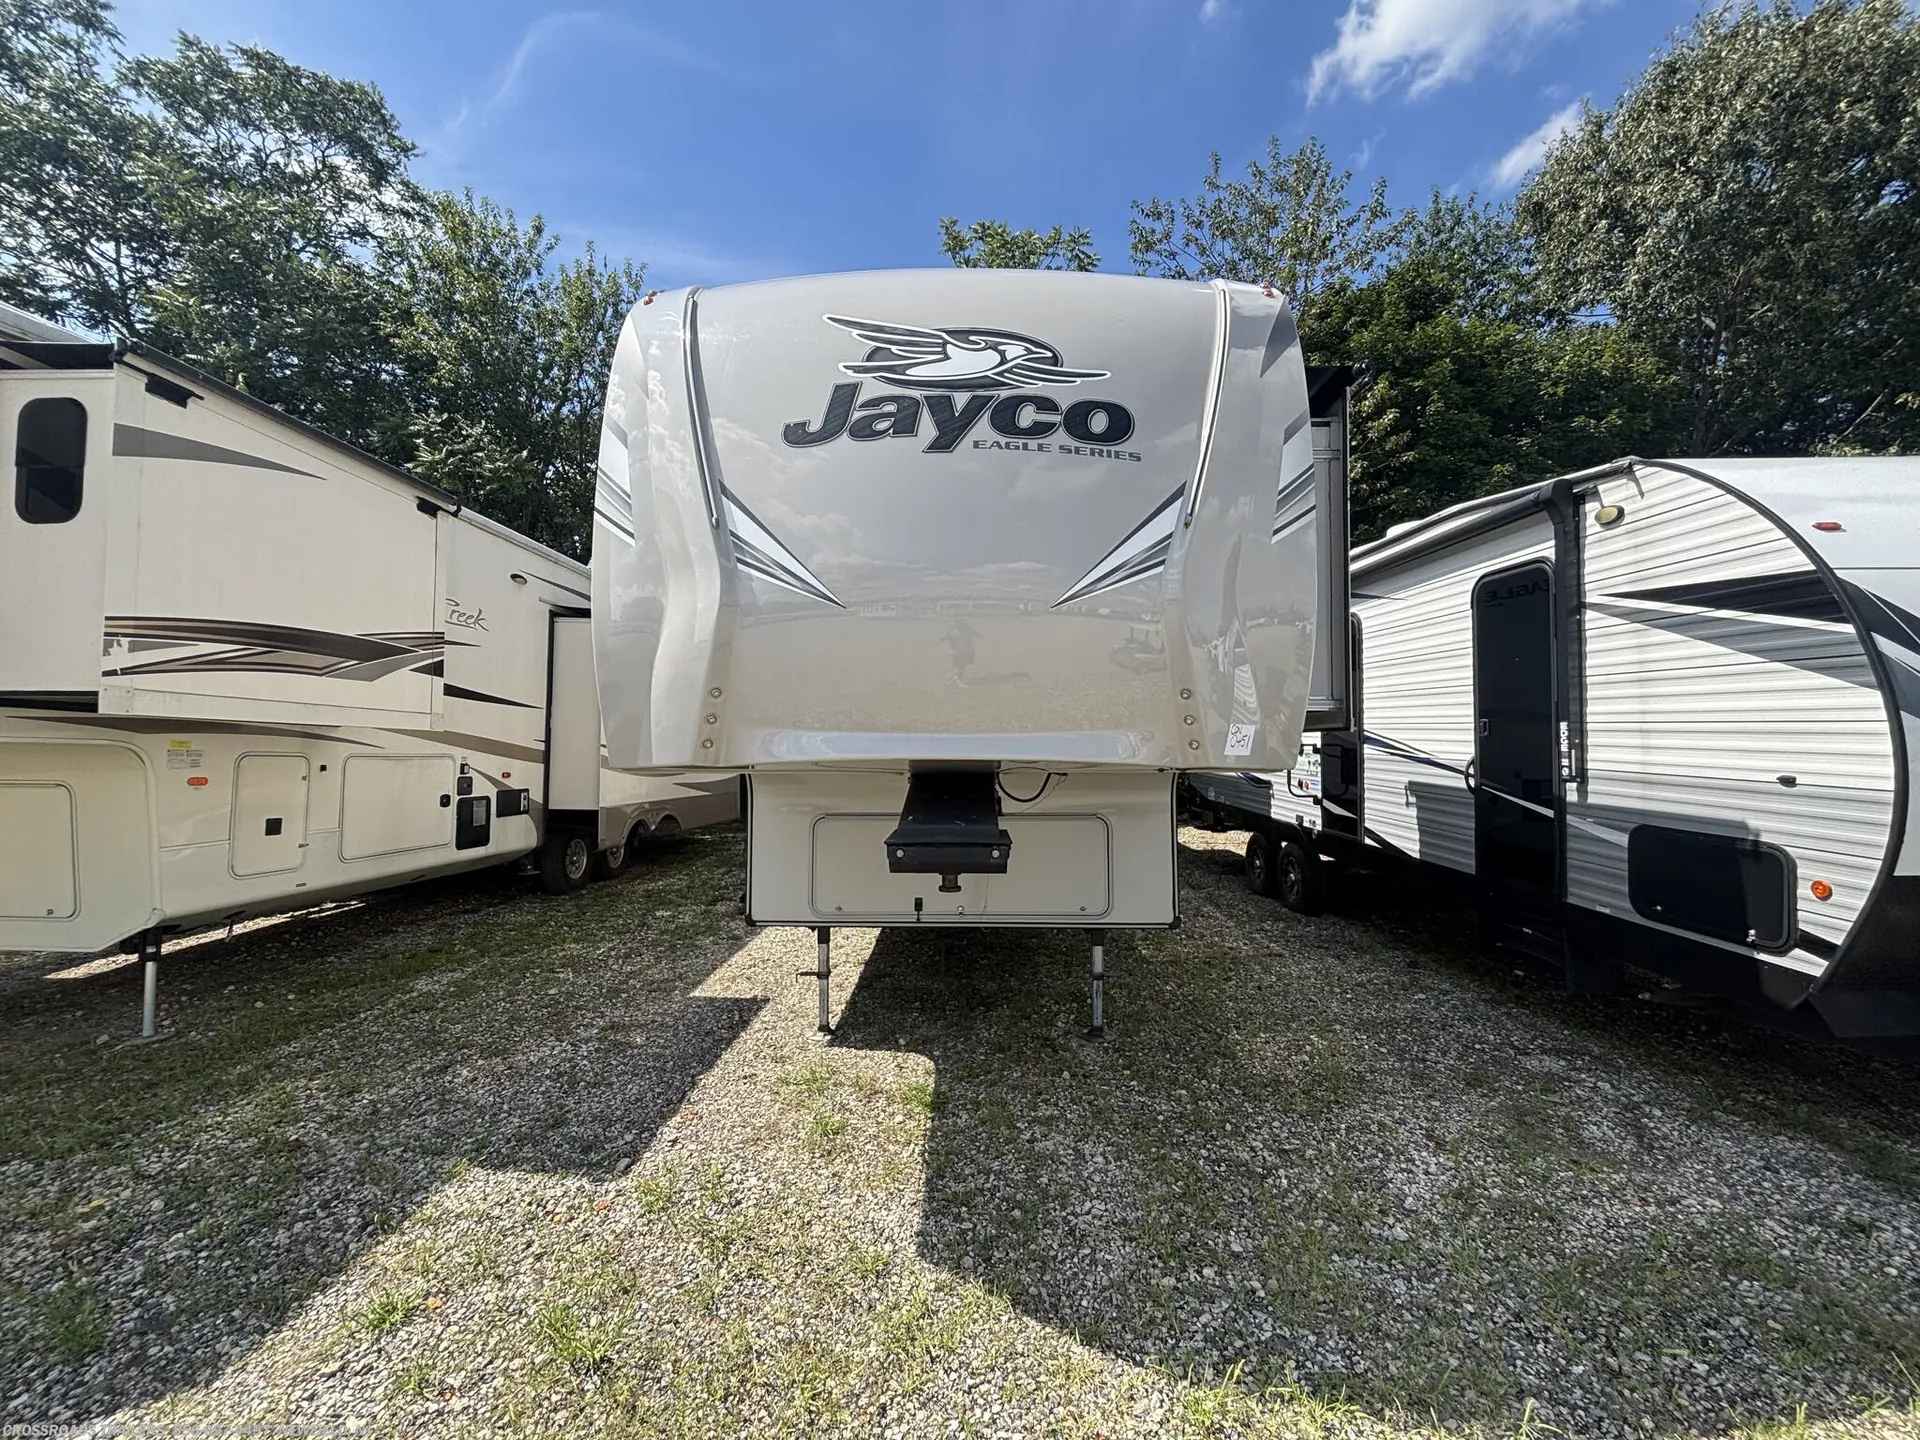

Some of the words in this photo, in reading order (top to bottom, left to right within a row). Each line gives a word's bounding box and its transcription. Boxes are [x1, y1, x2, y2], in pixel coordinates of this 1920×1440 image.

[780, 381, 1135, 454] Jayco
[972, 439, 1053, 454] EAGLE
[1058, 444, 1142, 463] SERIES
